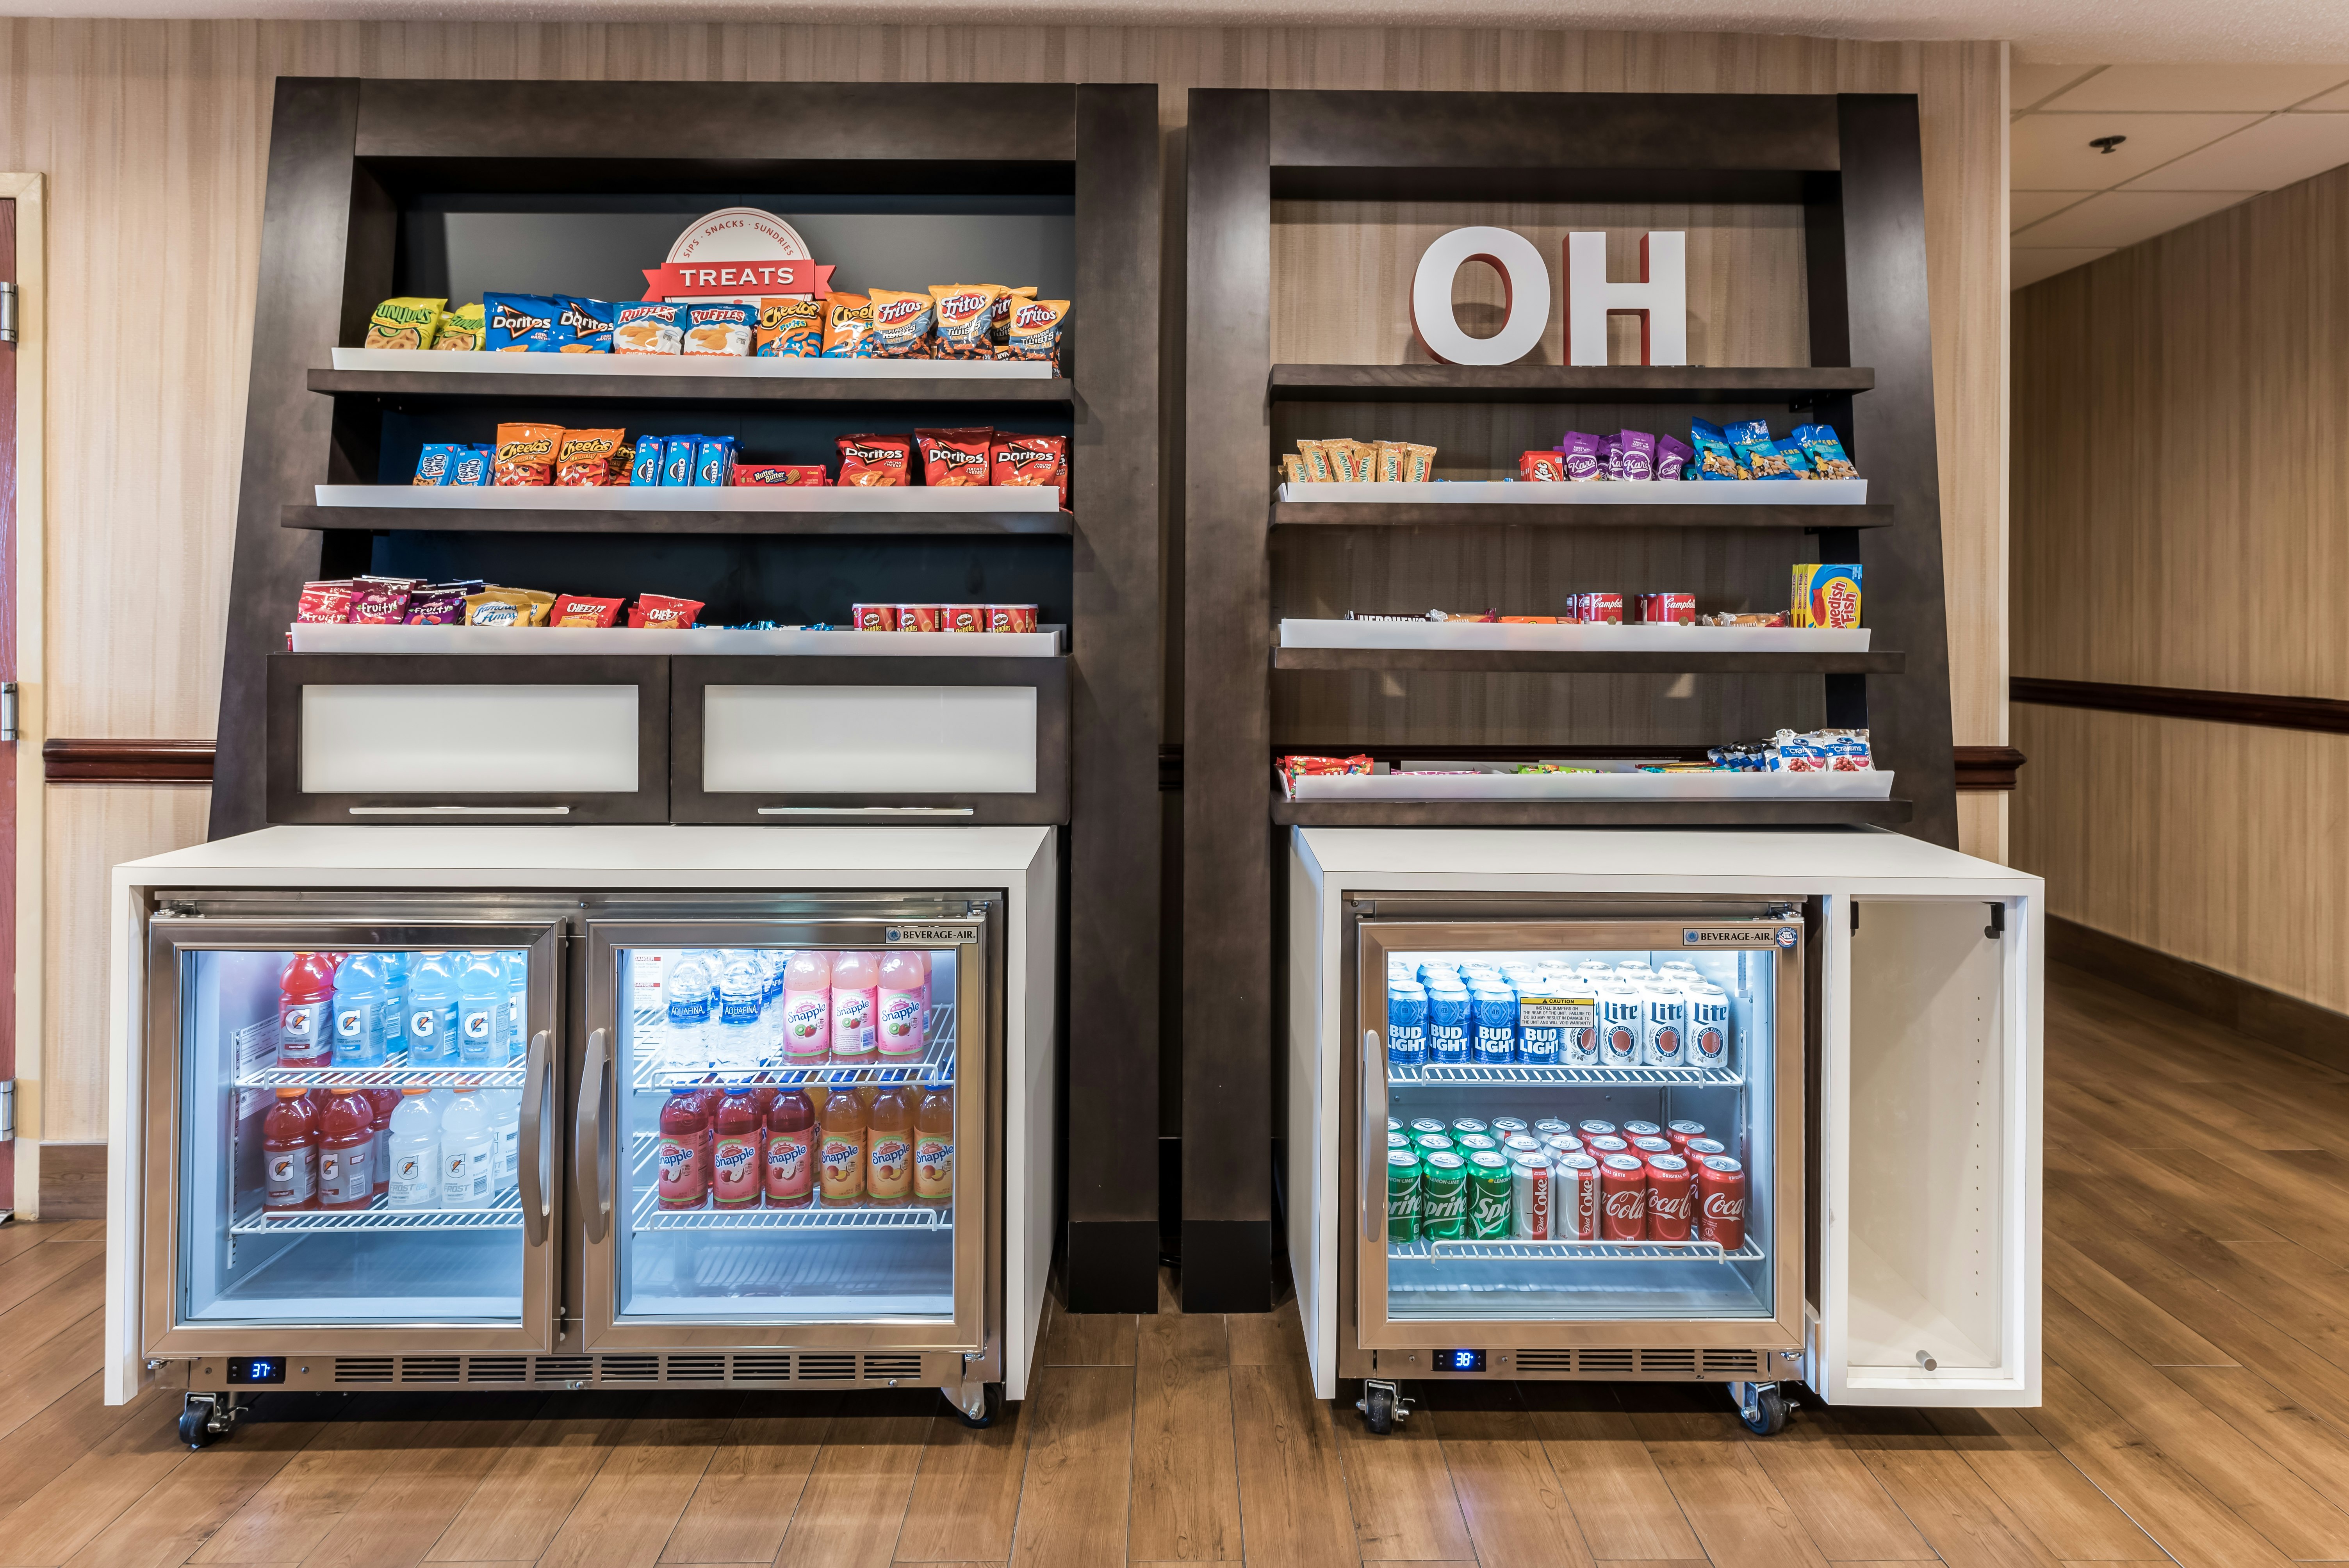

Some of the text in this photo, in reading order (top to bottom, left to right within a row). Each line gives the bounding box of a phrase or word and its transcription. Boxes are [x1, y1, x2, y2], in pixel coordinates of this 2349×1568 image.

[683, 220, 794, 258] SIPS SNACKS SUNDRIES
[679, 267, 794, 287] TREATS
[1410, 226, 1686, 366] OH
[618, 306, 675, 324] RUFFLES
[761, 301, 818, 328] Cheetos
[878, 301, 922, 323] Fritos
[941, 296, 986, 318] Fritos
[1016, 304, 1057, 328] Fritos
[493, 316, 551, 328] Doritos
[561, 312, 614, 332] Doritos
[692, 310, 745, 324] RUFFLES
[498, 439, 552, 461] Cheetos
[560, 438, 613, 462] Cheetos
[845, 447, 903, 458] Doritos
[930, 449, 984, 464] Doritos
[998, 451, 1054, 462] Doritos
[645, 458, 654, 483] OREO
[677, 458, 686, 482] OREO
[711, 460, 719, 484] OREO
[1568, 459, 1595, 473] Kar's
[1624, 460, 1648, 471] Kar's
[754, 469, 775, 481] Nutter
[765, 472, 785, 483] Butter
[306, 612, 342, 623] fruity
[362, 603, 394, 614] fruity
[1841, 592, 1857, 625] Fish
[477, 611, 517, 625] Amos
[1701, 932, 1770, 941] BEVERAGE-AIR
[671, 1005, 703, 1016] AQUAFINA
[724, 1005, 756, 1015] AQUAFINA
[788, 1003, 826, 1023] Snapple
[836, 1000, 870, 1017] Snapple
[882, 1002, 920, 1022] Snapple
[1604, 1001, 1638, 1024] Lite
[1650, 1002, 1683, 1025] Lite
[1693, 1002, 1727, 1025] Lite
[285, 1009, 310, 1035] G
[337, 1010, 361, 1036] G
[411, 1010, 434, 1037] G
[464, 1010, 488, 1038] G
[1658, 1027, 1666, 1035] FINE
[1390, 1024, 1422, 1039] BUD
[1431, 1024, 1462, 1039] BUD
[1479, 1026, 1511, 1041] BUD
[1525, 1028, 1557, 1042] BUD
[1620, 1026, 1634, 1040] PILSNER
[1700, 1028, 1709, 1036] FINE
[1388, 1037, 1426, 1051] LIGHT
[1429, 1036, 1468, 1051] LIGHT
[1475, 1036, 1515, 1053] LIGHT
[1520, 1038, 1558, 1054] LIGHT
[659, 1149, 693, 1167] Snapple
[715, 1147, 754, 1167] Snapple
[768, 1144, 806, 1165] Snapple
[822, 1146, 858, 1164] Snapple
[872, 1144, 911, 1165] Snapple
[916, 1145, 953, 1164] Snapple
[269, 1155, 294, 1182] G
[321, 1153, 339, 1181] G
[397, 1155, 419, 1180] G
[445, 1154, 466, 1178] G
[444, 1184, 471, 1193] FROST
[1534, 1179, 1547, 1215] Coke
[1580, 1180, 1593, 1216] Coke
[1456, 1352, 1470, 1366] 38
[253, 1363, 267, 1377] 37
